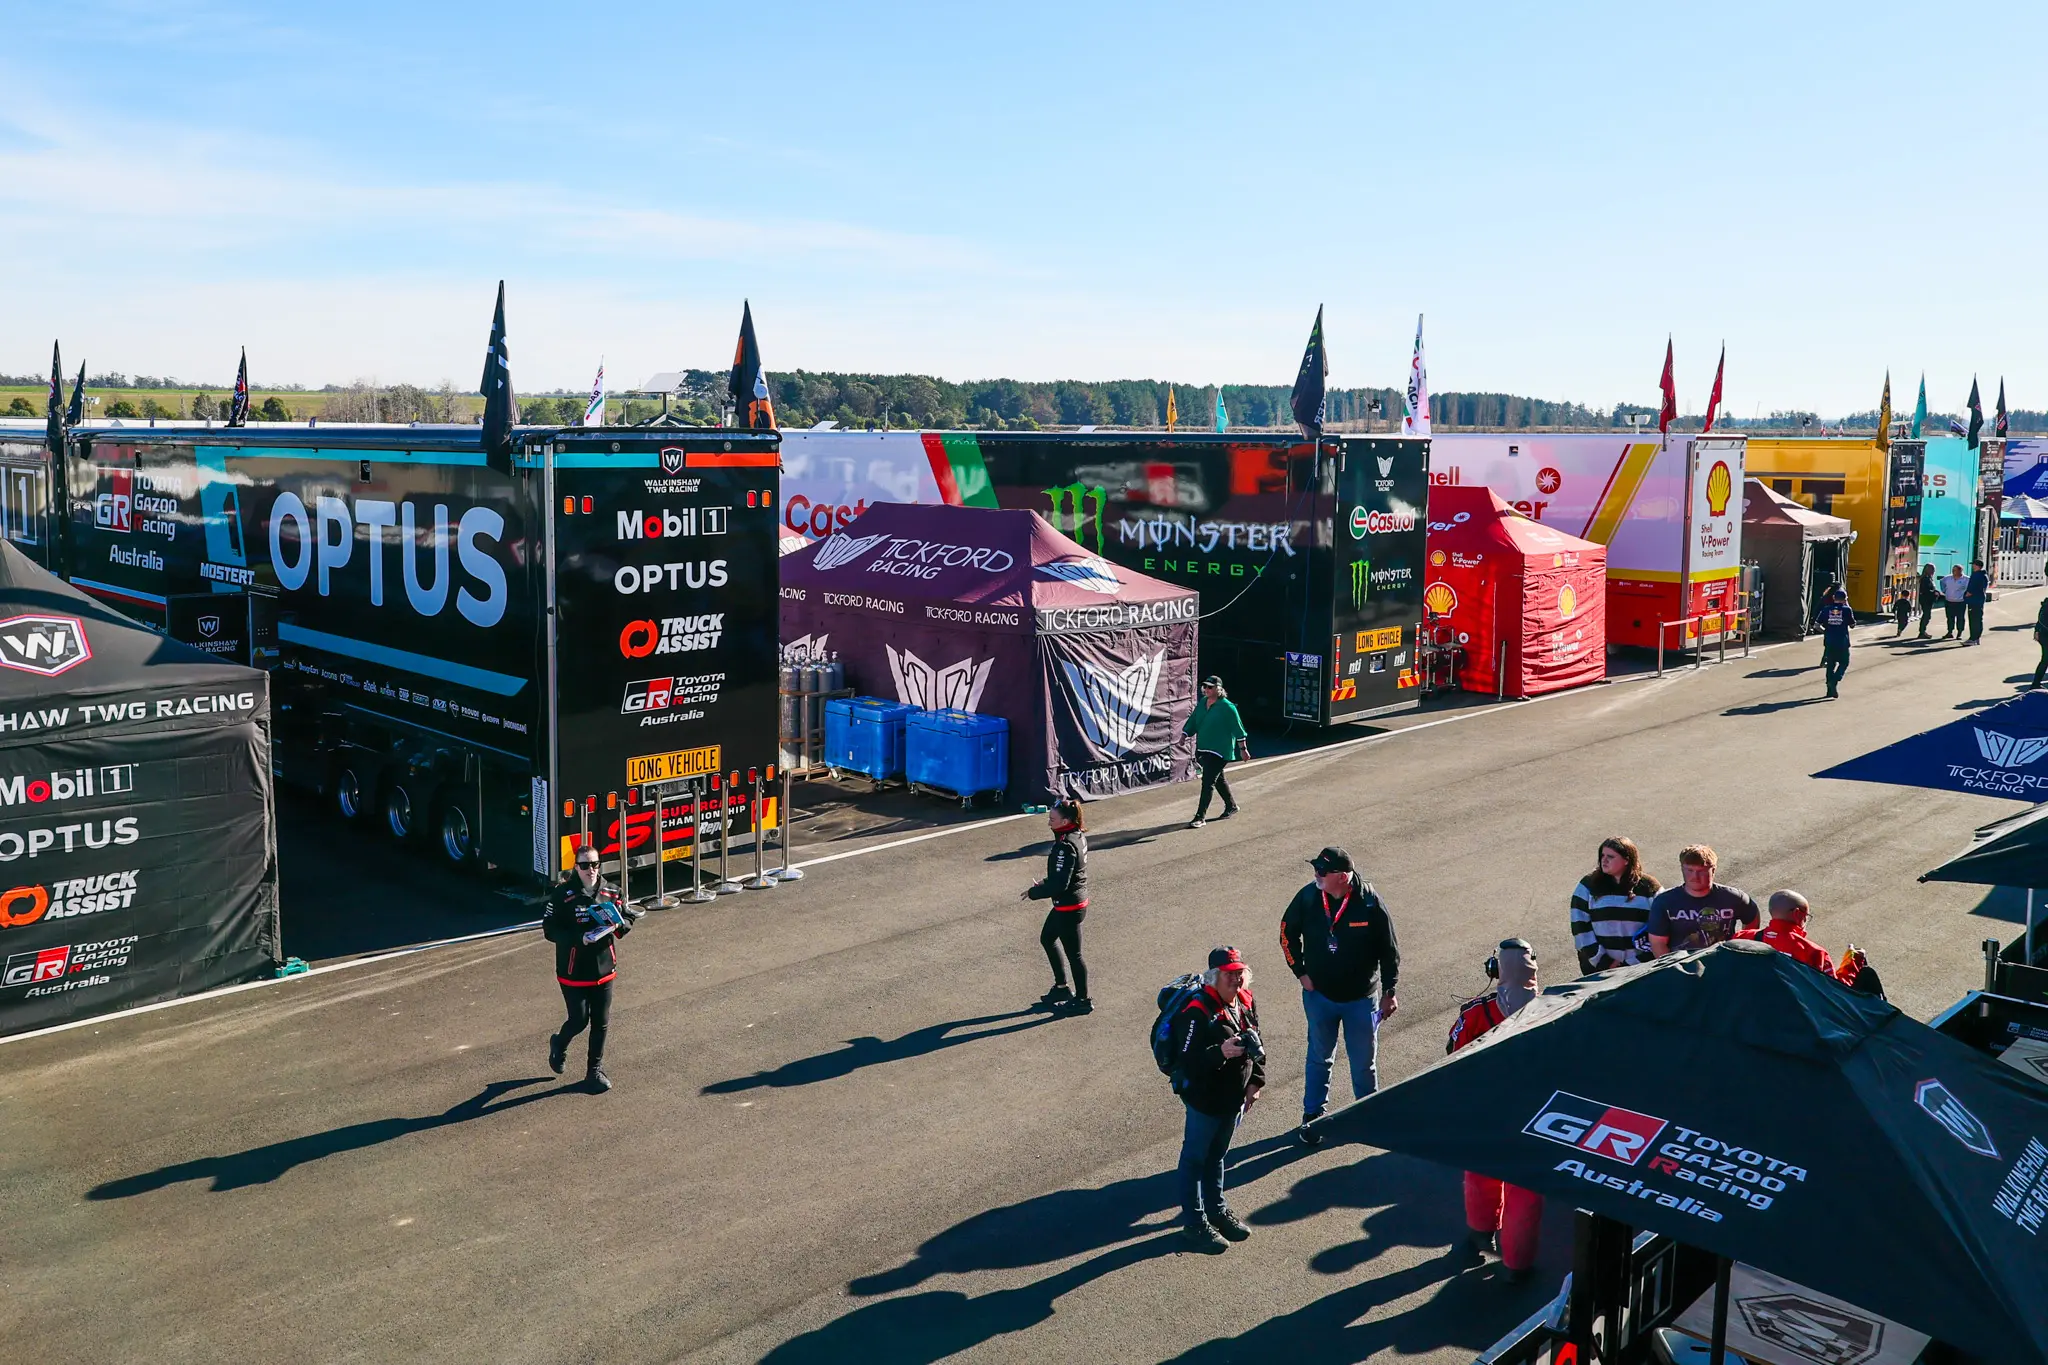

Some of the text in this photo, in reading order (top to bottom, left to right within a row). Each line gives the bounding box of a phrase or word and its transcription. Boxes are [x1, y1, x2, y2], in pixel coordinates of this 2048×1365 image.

[135, 474, 182, 493] TOYOTA
[644, 478, 701, 487] WALKINSHAW
[668, 485, 699, 493] RACING
[95, 488, 131, 531] GR
[135, 493, 178, 513] GAZOO
[133, 514, 176, 541] Racing
[617, 507, 696, 540] Mobil
[1368, 508, 1416, 534] Castrol
[1701, 523, 1713, 533] Shell
[1119, 514, 1296, 557] MONSTER
[1701, 536, 1729, 548] V-Power
[110, 544, 164, 571] Australia
[269, 491, 507, 627] OPTUS
[881, 539, 1013, 573] TICKFORD
[1144, 558, 1266, 577] ENERGY
[1453, 557, 1480, 565] V-Power
[200, 562, 255, 585] MOSTERT
[614, 560, 728, 594] OPTUS
[866, 560, 942, 580] RACING
[1371, 568, 1412, 583] MONSTER
[823, 592, 904, 614] TICKFORD RACING
[1041, 598, 1195, 630] TICKFORD RACING
[661, 613, 725, 635] TRUCK
[925, 605, 1019, 626] TICKFORD RACING
[655, 631, 722, 655] ASSIST
[1358, 631, 1400, 650] LONG VEHICLE
[1302, 654, 1318, 664] 2026
[673, 683, 720, 696] GAZOO
[675, 672, 726, 686] TOYOTA
[79, 701, 147, 724] TWG
[156, 692, 255, 718] RACING
[623, 687, 670, 712] GR
[672, 691, 718, 706] Racing
[640, 709, 704, 727] Australia
[631, 749, 717, 782] LONG VEHICLE
[1060, 755, 1171, 788] TICKFORD RACING
[0, 768, 94, 806] Mobil
[1963, 779, 2025, 794] RACING
[661, 794, 746, 818] SUPRCRS
[661, 805, 746, 828] CHAMIONHIP
[0, 817, 140, 862] OPTUS
[53, 869, 140, 900] TRUCK
[44, 888, 137, 921] ASSIST
[72, 946, 131, 964] GAZOO
[73, 935, 139, 953] TOYOTA
[4, 959, 67, 986] GR
[68, 955, 128, 974] Racing
[25, 974, 111, 999] Australia
[1530, 1107, 1650, 1163] GR
[1674, 1126, 1807, 1182] TOYOTA
[1659, 1142, 1786, 1192] GAZOO
[1553, 1159, 1723, 1223] Australia
[1647, 1156, 1774, 1210] Racing
